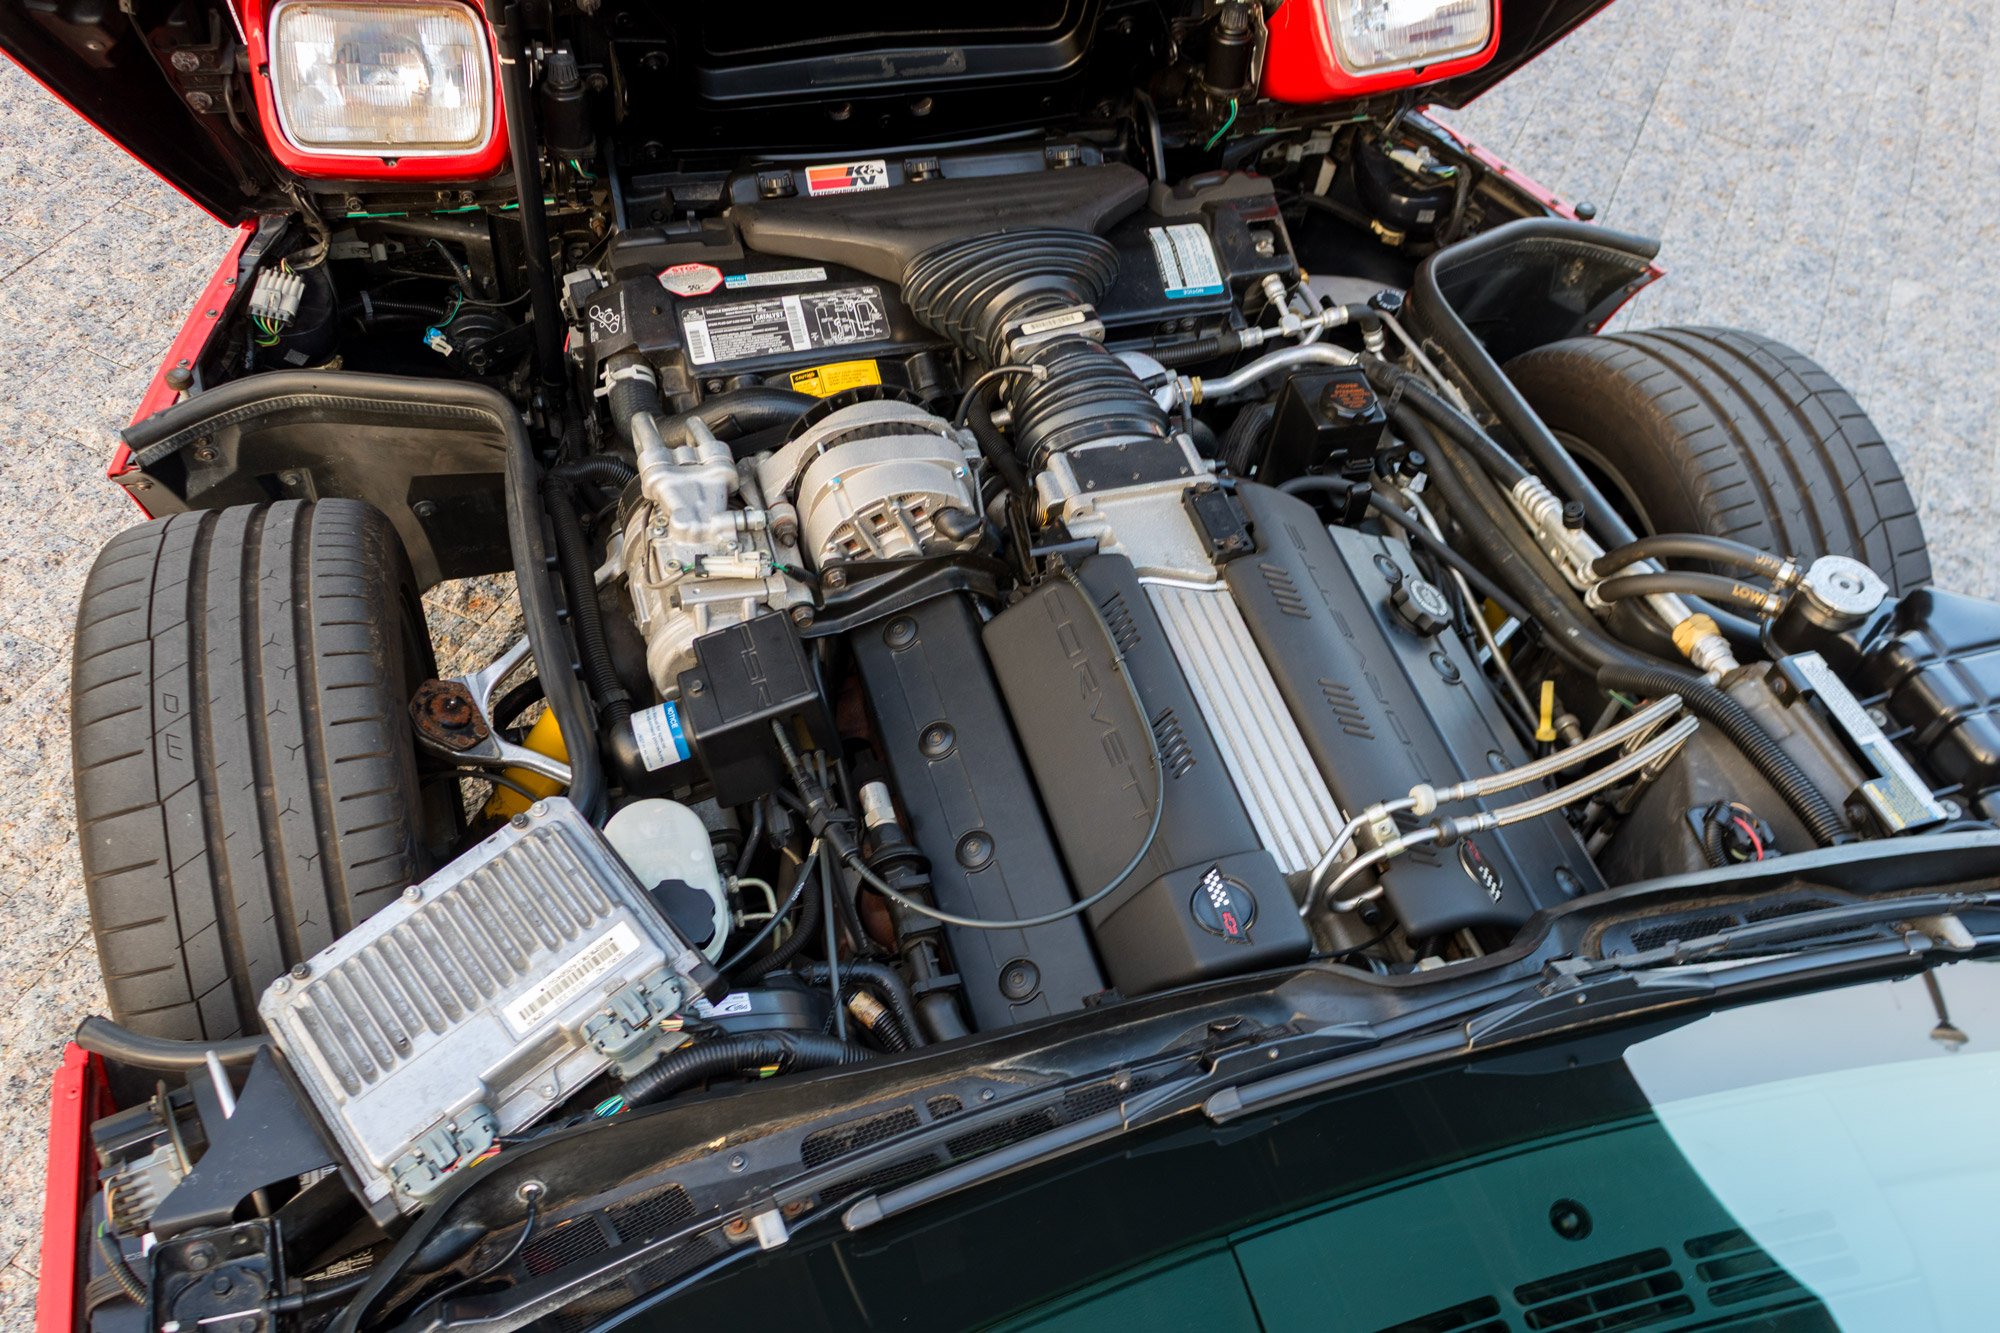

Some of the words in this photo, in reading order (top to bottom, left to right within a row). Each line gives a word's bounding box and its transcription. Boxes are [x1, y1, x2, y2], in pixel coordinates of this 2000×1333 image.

[846, 164, 884, 186] K&N
[672, 265, 699, 274] STOP
[755, 311, 784, 321] CATALYST
[795, 371, 816, 382] CAUTION
[667, 706, 679, 729] NOTICE
